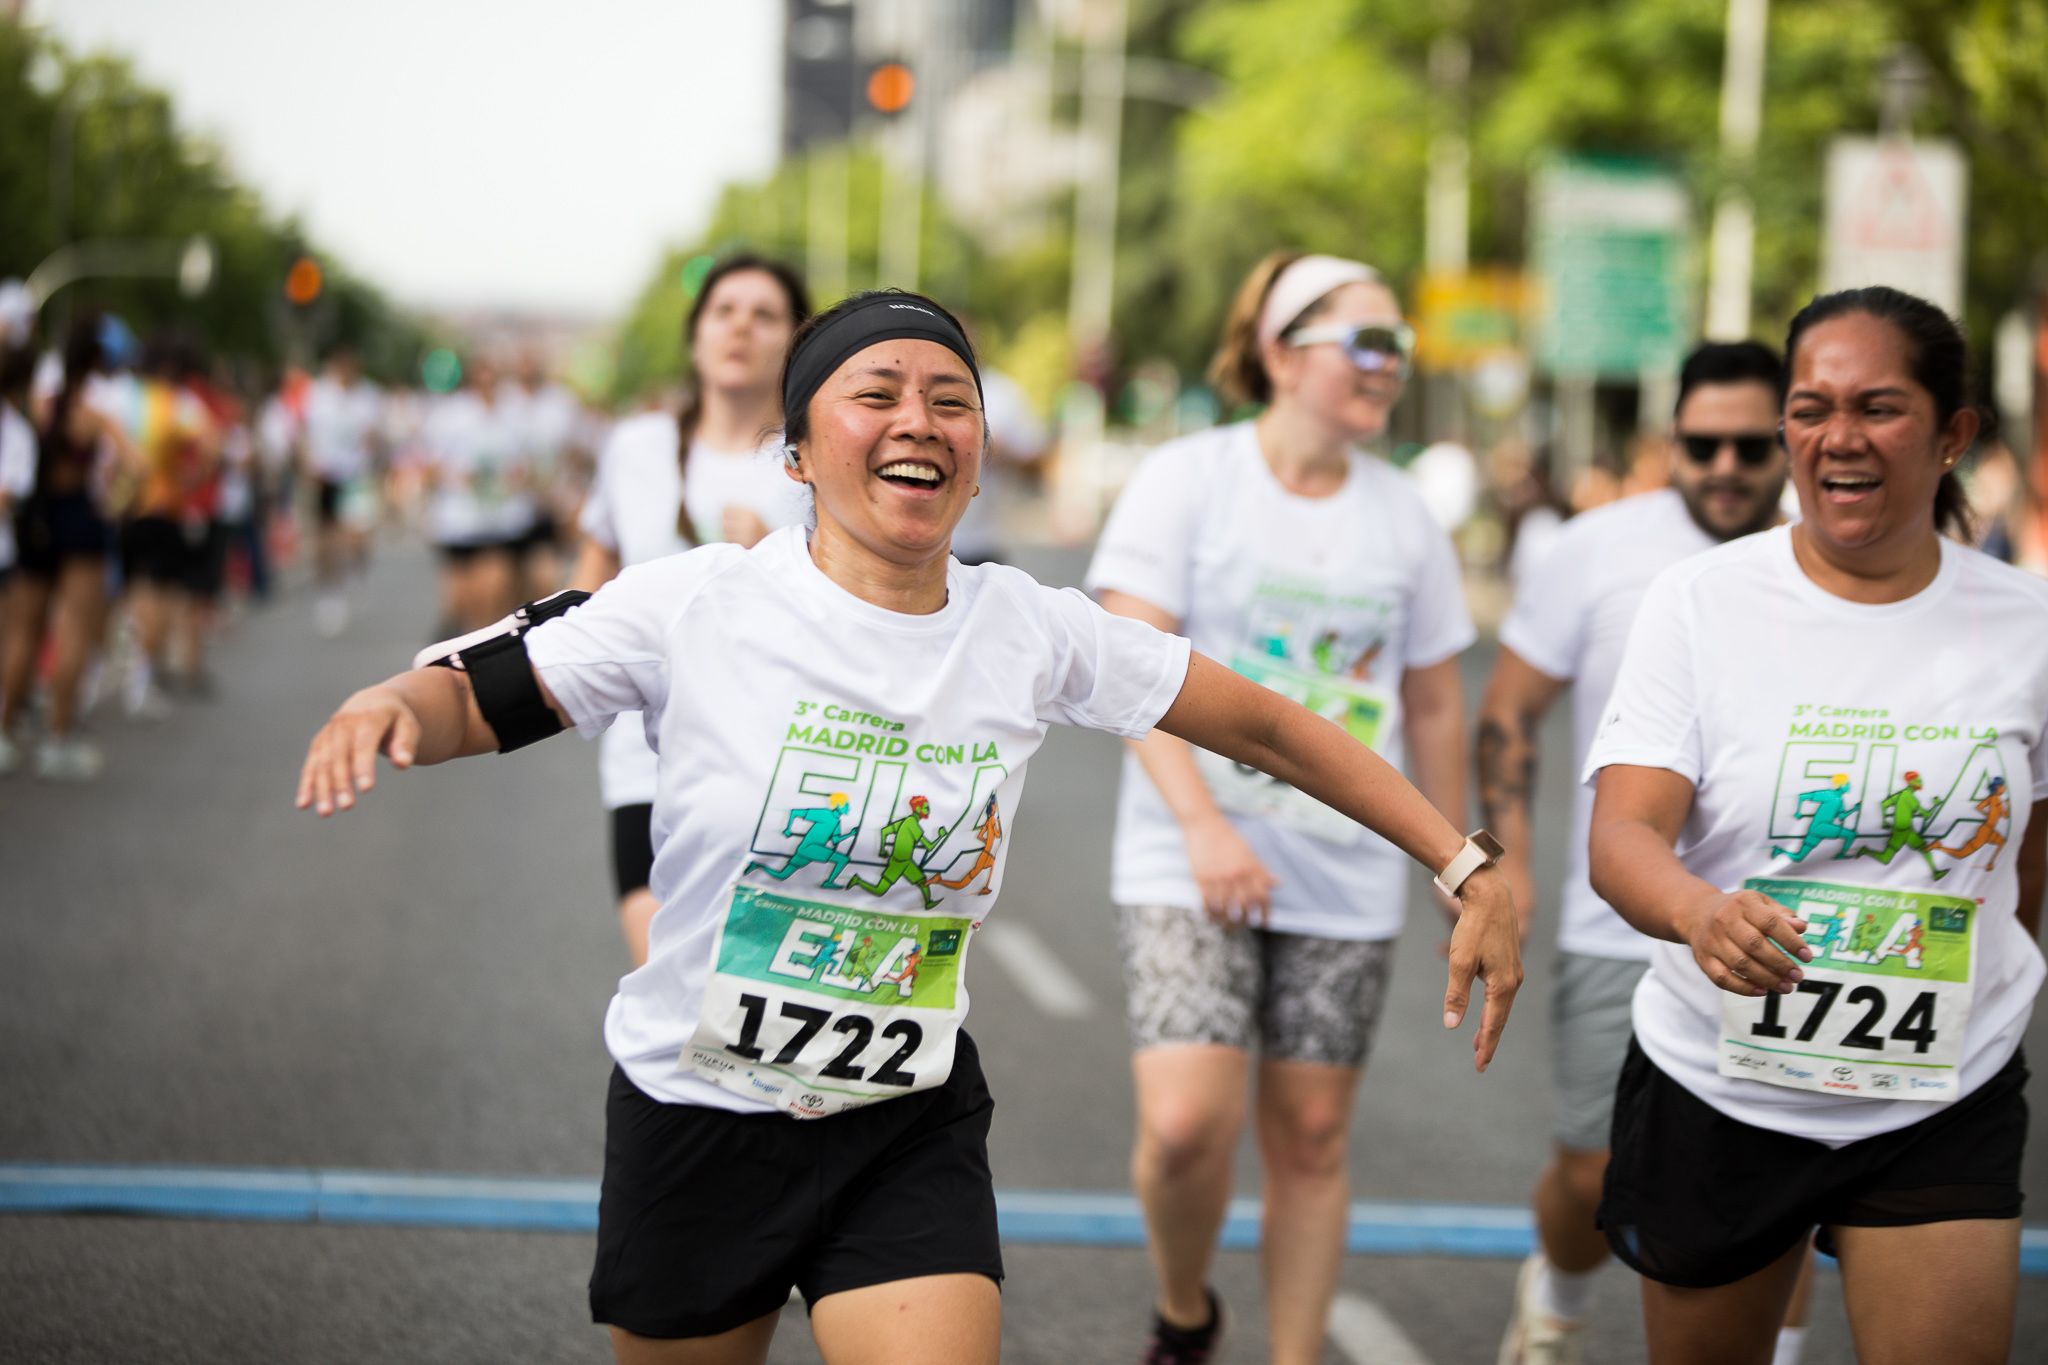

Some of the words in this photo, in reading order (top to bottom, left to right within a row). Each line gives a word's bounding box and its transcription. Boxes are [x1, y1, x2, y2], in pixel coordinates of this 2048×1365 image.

[823, 705, 905, 732] Carrera
[1788, 723, 1895, 740] MADRID
[1903, 724, 1960, 741] CON
[1969, 727, 1999, 742] LA
[1818, 705, 1889, 718] Carrera
[786, 723, 909, 757] MADRID
[915, 744, 964, 764] CON
[971, 741, 998, 762] LA
[750, 746, 1009, 872] ELA
[1768, 742, 2013, 840] ELA
[797, 907, 863, 926] MADRID
[864, 918, 898, 933] CON
[900, 922, 920, 935] LA
[1801, 888, 1860, 905] MADRID
[1864, 894, 1896, 908] CON
[1898, 898, 1918, 910] LA
[768, 918, 918, 997] ELA
[1797, 901, 1923, 969] ELA
[725, 993, 923, 1088] 1722
[1751, 979, 1938, 1054] 1724
